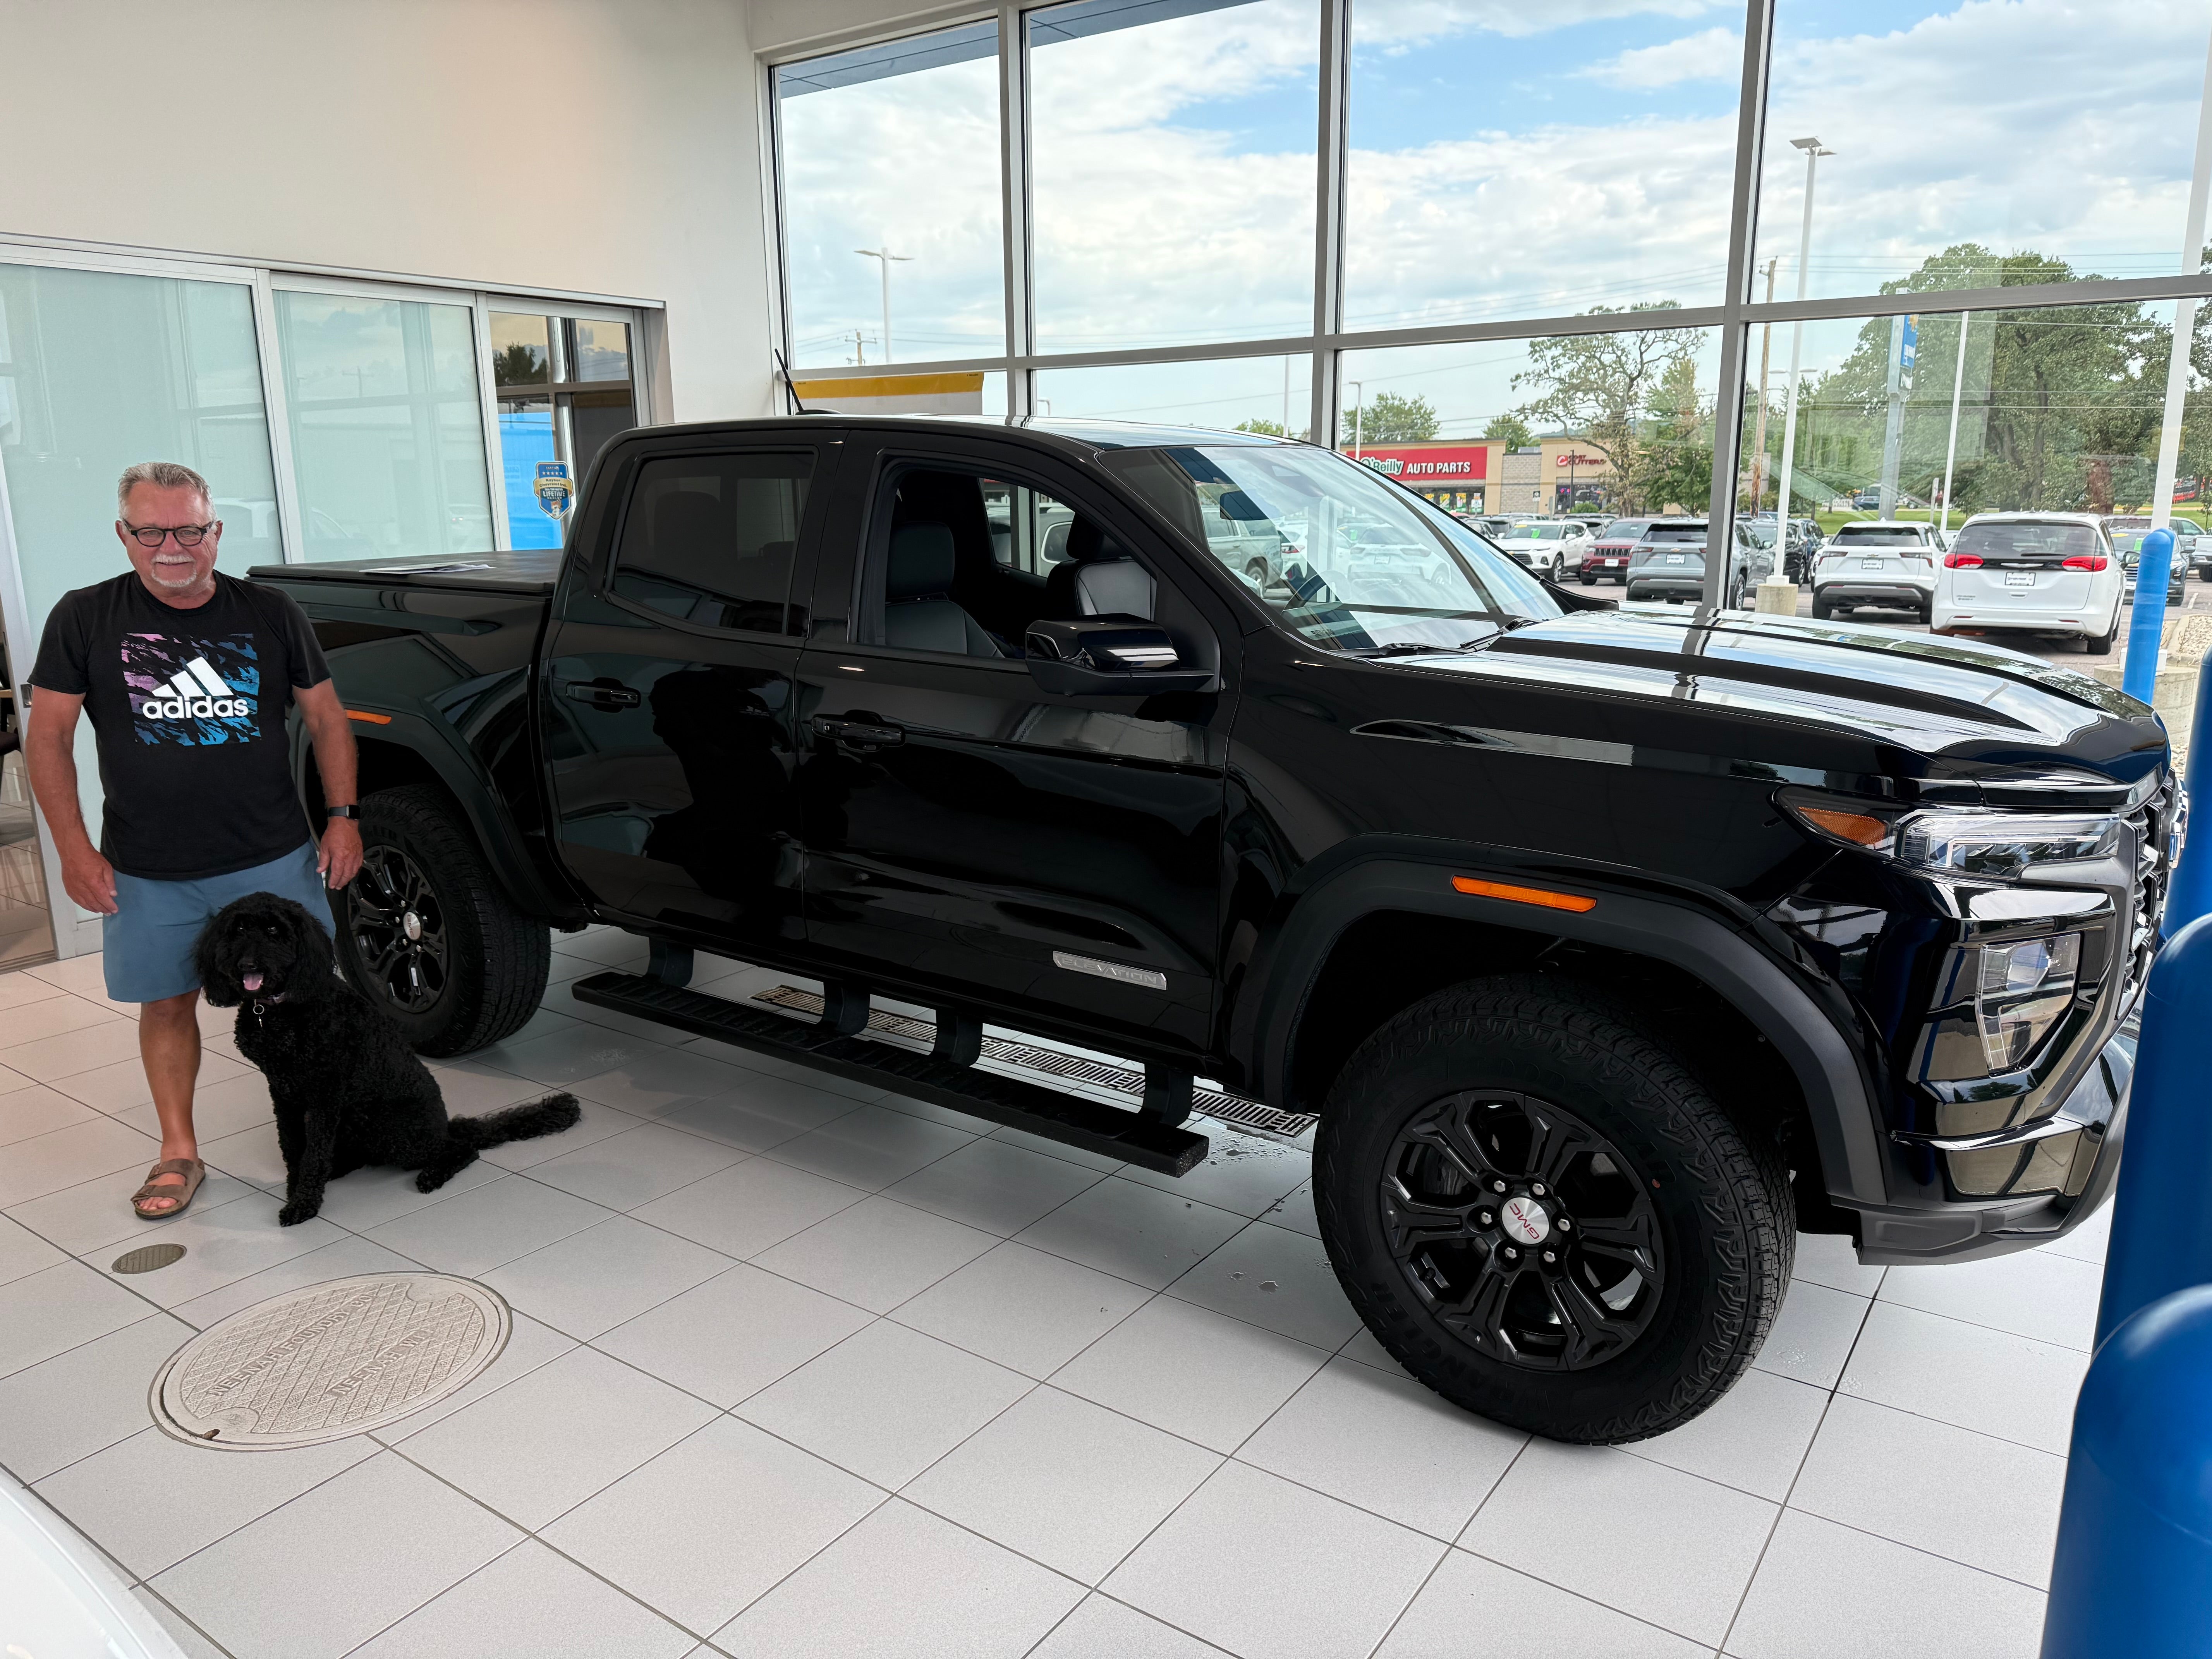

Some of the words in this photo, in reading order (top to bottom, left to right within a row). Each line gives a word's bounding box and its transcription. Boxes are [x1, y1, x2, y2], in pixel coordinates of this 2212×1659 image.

[1407, 463, 1433, 474] AUTO
[1436, 462, 1471, 473] PARTS
[142, 696, 249, 719] adidas
[1062, 958, 1157, 984] ELEVATION
[1510, 1203, 1540, 1239] GMC
[208, 1352, 285, 1396] NEENAH
[280, 1308, 350, 1351] FOUNDRY
[332, 1352, 403, 1394] NEENAH
